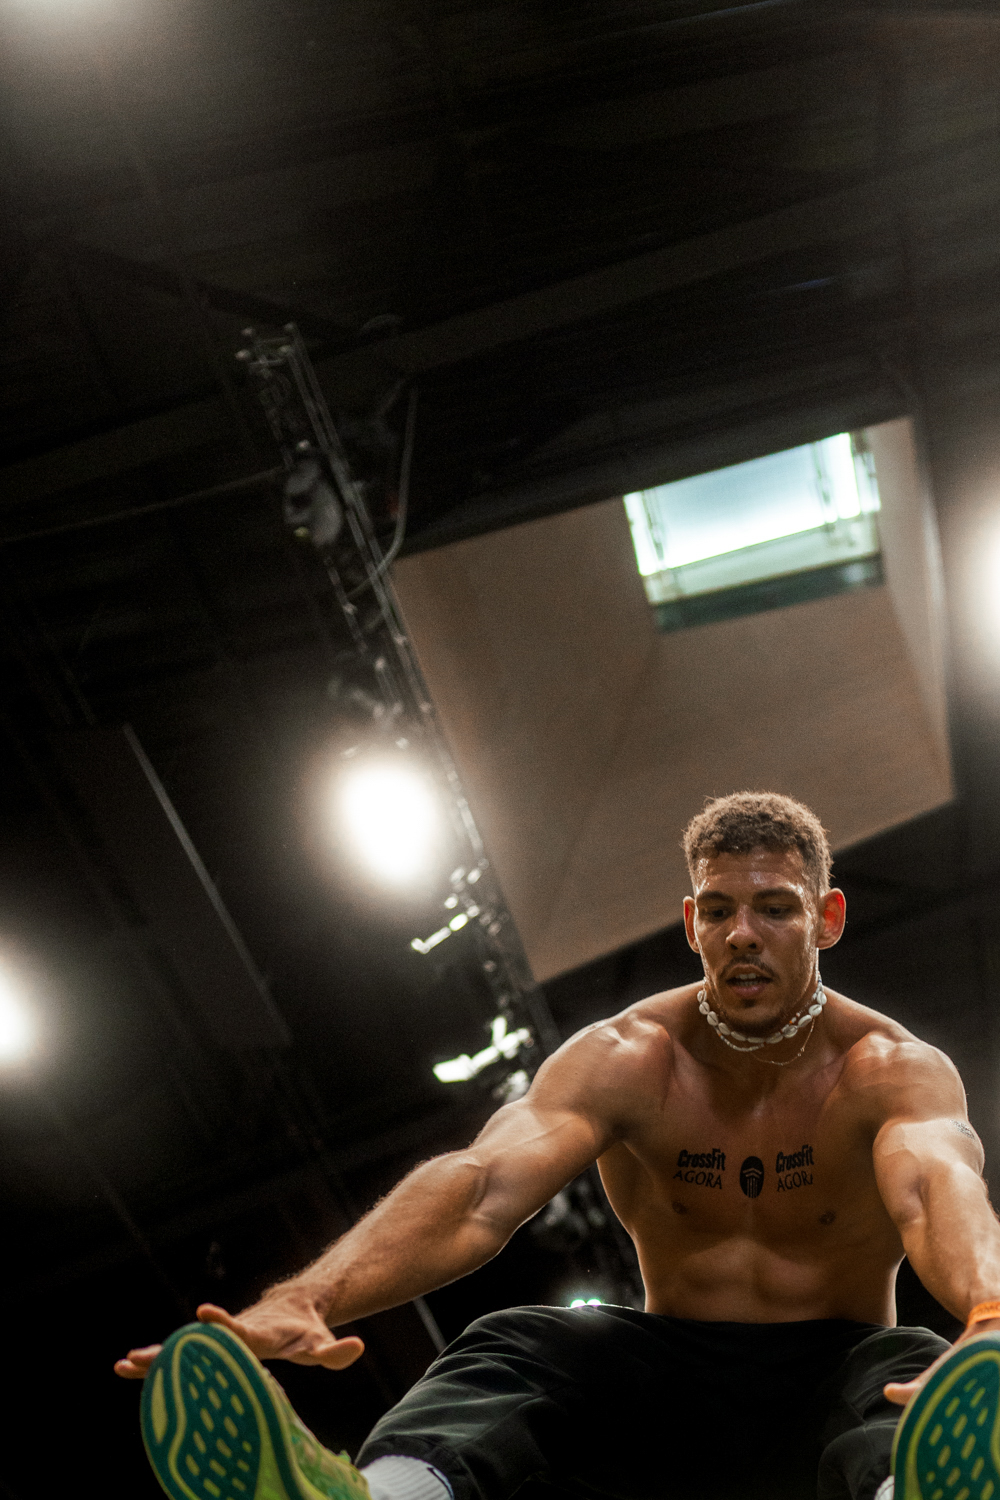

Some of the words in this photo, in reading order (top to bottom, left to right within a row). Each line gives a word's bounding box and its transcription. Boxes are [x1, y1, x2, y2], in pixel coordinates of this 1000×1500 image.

[677, 1148, 726, 1171] CrossFit
[775, 1144, 815, 1174] CrossFit
[673, 1170, 722, 1189] AGORA
